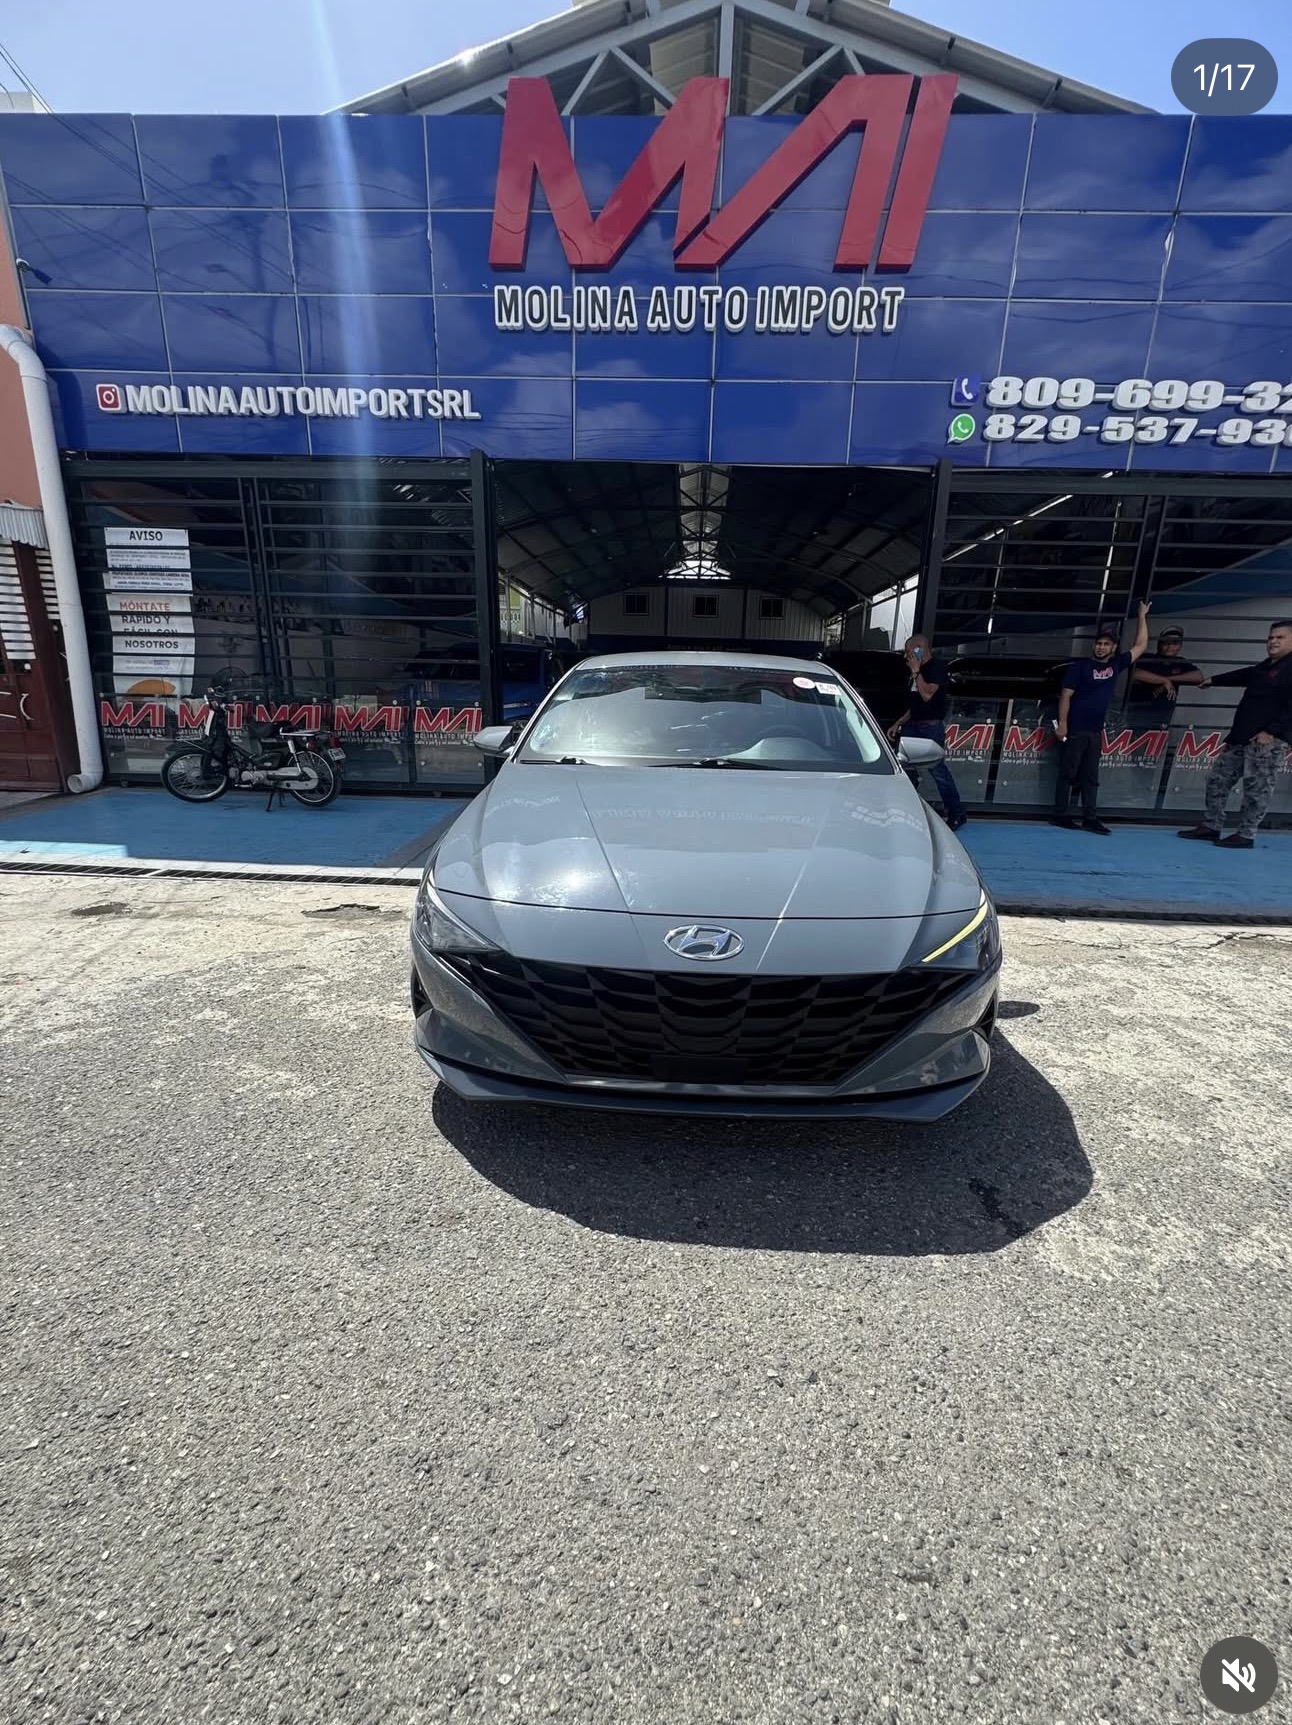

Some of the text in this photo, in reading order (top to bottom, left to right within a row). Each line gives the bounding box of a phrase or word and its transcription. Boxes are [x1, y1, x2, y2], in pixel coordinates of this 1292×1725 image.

[488, 74, 959, 273] MAI
[494, 285, 905, 333] MOLINA AUTO IMPORT
[126, 384, 481, 420] MOLINAAUTOIMPORTSRL
[983, 414, 1292, 445] 829-537-93
[129, 530, 163, 541] AVISO
[162, 615, 171, 624] Y
[125, 640, 179, 649] NOSOTROS
[101, 701, 166, 728] MAI
[334, 705, 402, 731] MAI
[414, 707, 482, 733] MAI
